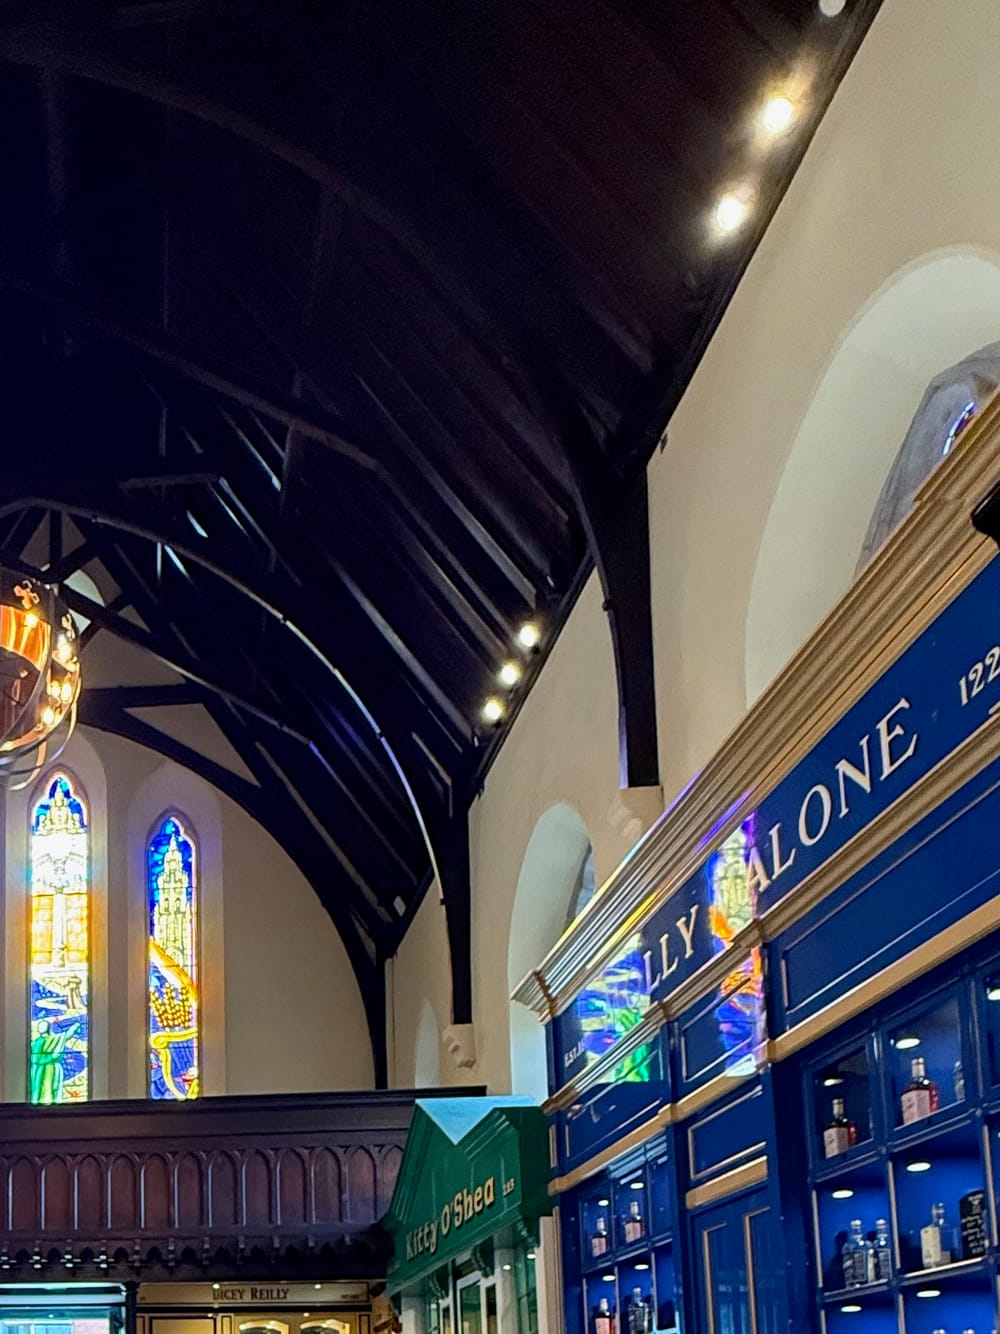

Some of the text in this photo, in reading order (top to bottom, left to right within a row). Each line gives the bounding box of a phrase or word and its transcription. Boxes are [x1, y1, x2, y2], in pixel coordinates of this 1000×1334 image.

[958, 645, 1000, 708] 122
[406, 1220, 438, 1261] Kitty
[441, 1176, 495, 1236] O'Shea
[212, 1287, 289, 1300] DICEY REILLY
